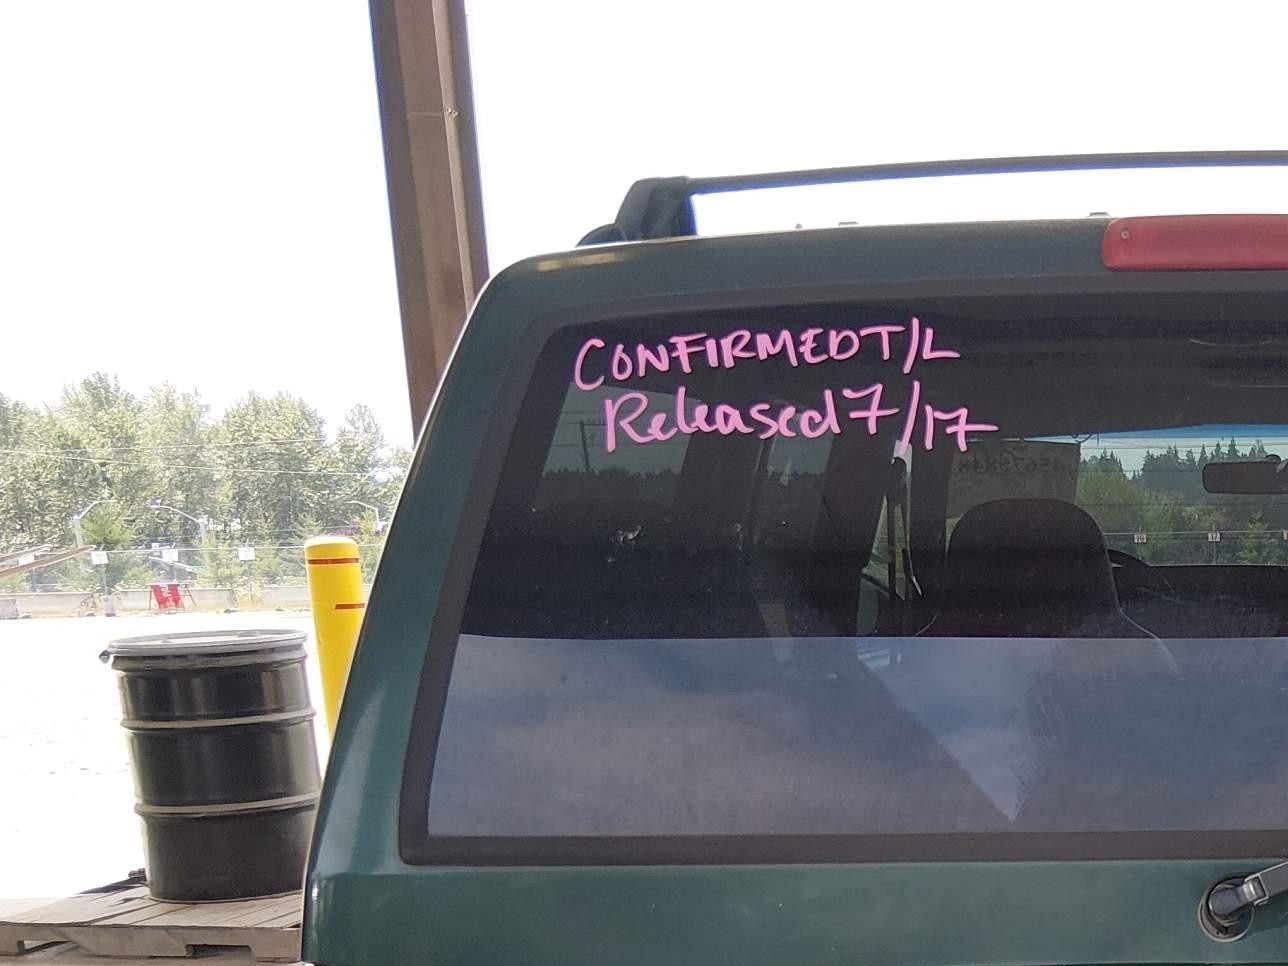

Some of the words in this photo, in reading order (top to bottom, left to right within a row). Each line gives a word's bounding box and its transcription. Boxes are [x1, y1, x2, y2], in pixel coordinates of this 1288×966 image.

[574, 327, 861, 390] CONFIRMED
[605, 386, 841, 453] Released
[841, 380, 999, 453] 7/17
